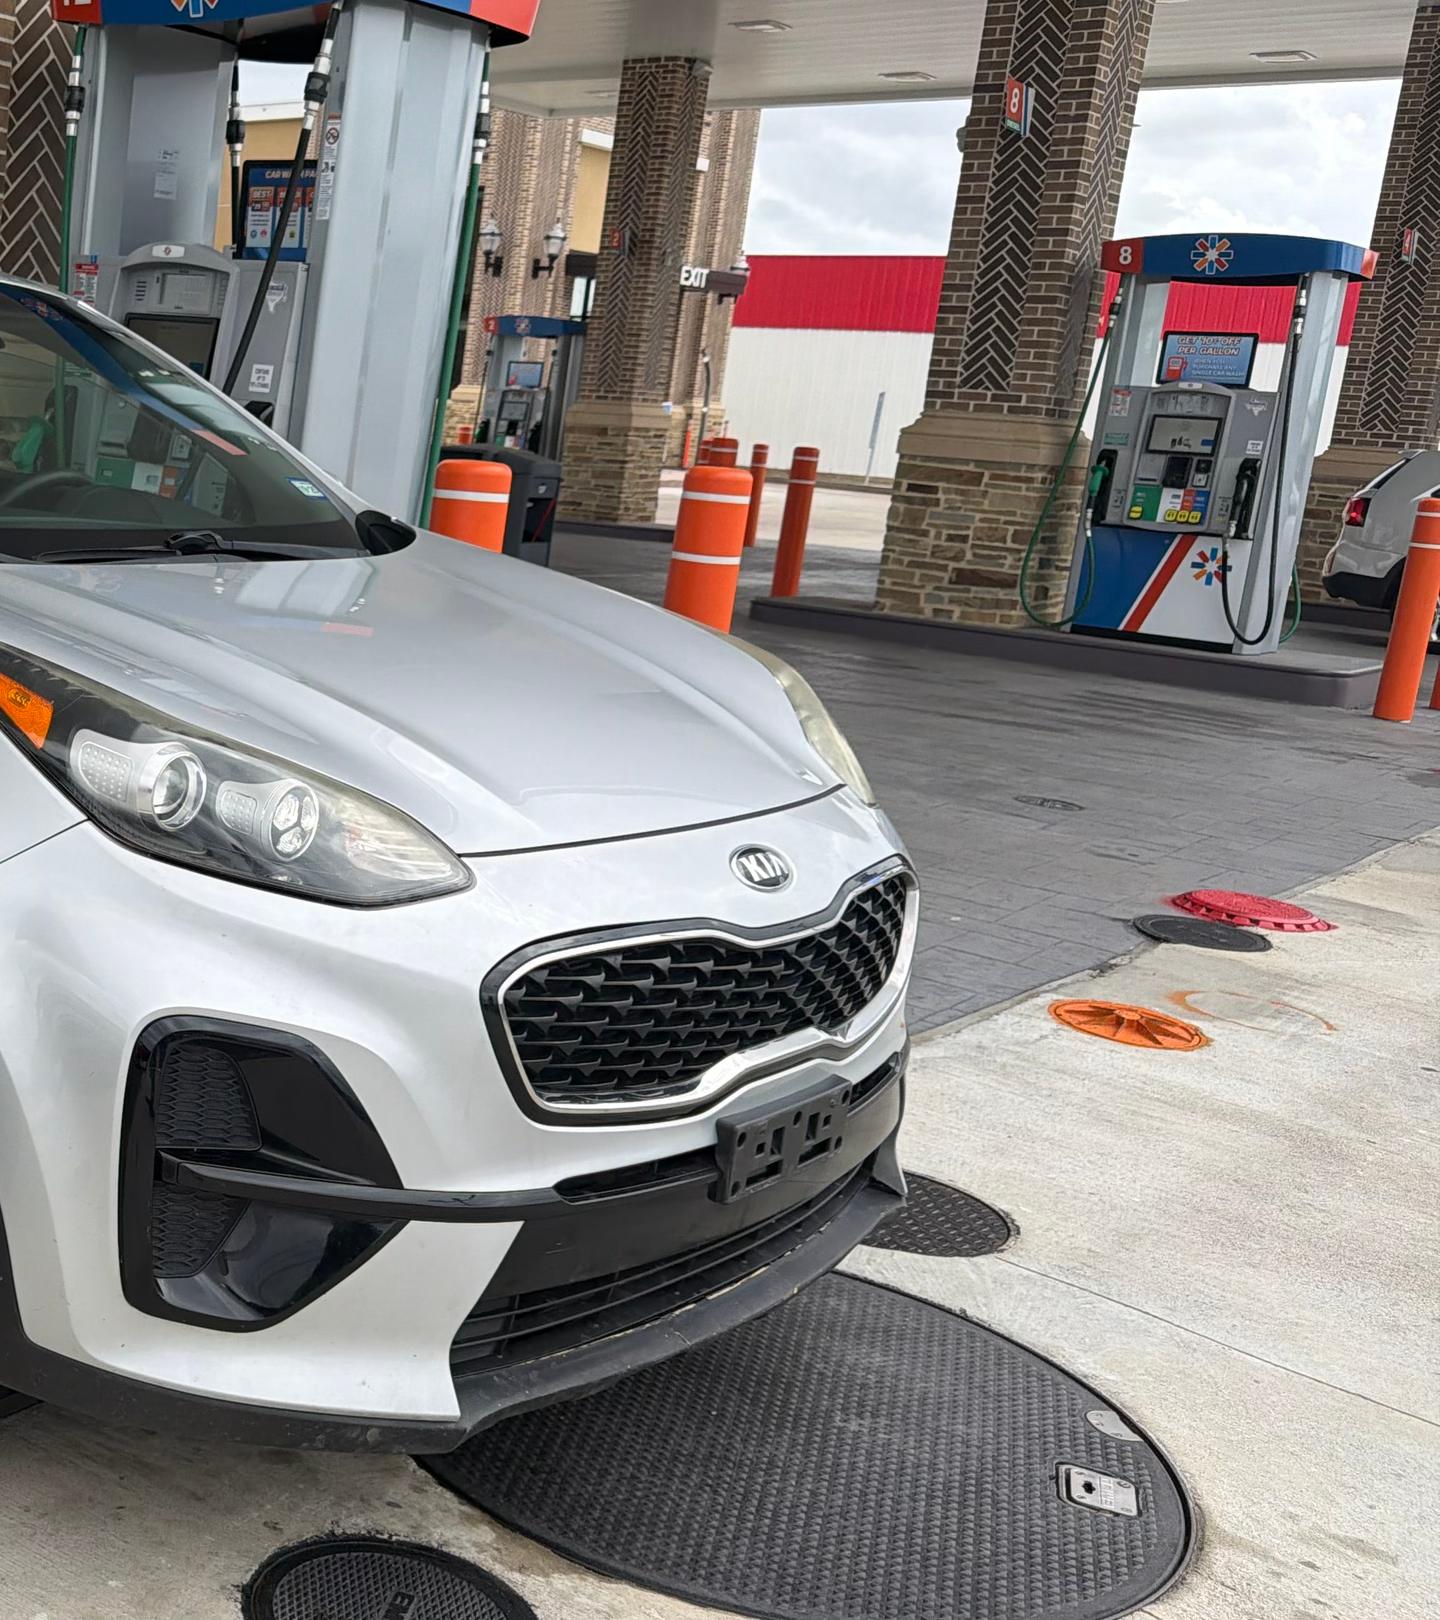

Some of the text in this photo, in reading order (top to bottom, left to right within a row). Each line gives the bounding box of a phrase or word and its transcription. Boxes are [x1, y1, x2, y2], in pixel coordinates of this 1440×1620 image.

[1010, 87, 1020, 113] 8
[1119, 246, 1132, 265] 8
[680, 266, 710, 289] EXIT
[1178, 336, 1198, 345] GET
[1220, 336, 1242, 346] OFF
[1178, 346, 1240, 356] PER GALLON
[738, 851, 789, 882] KIA
